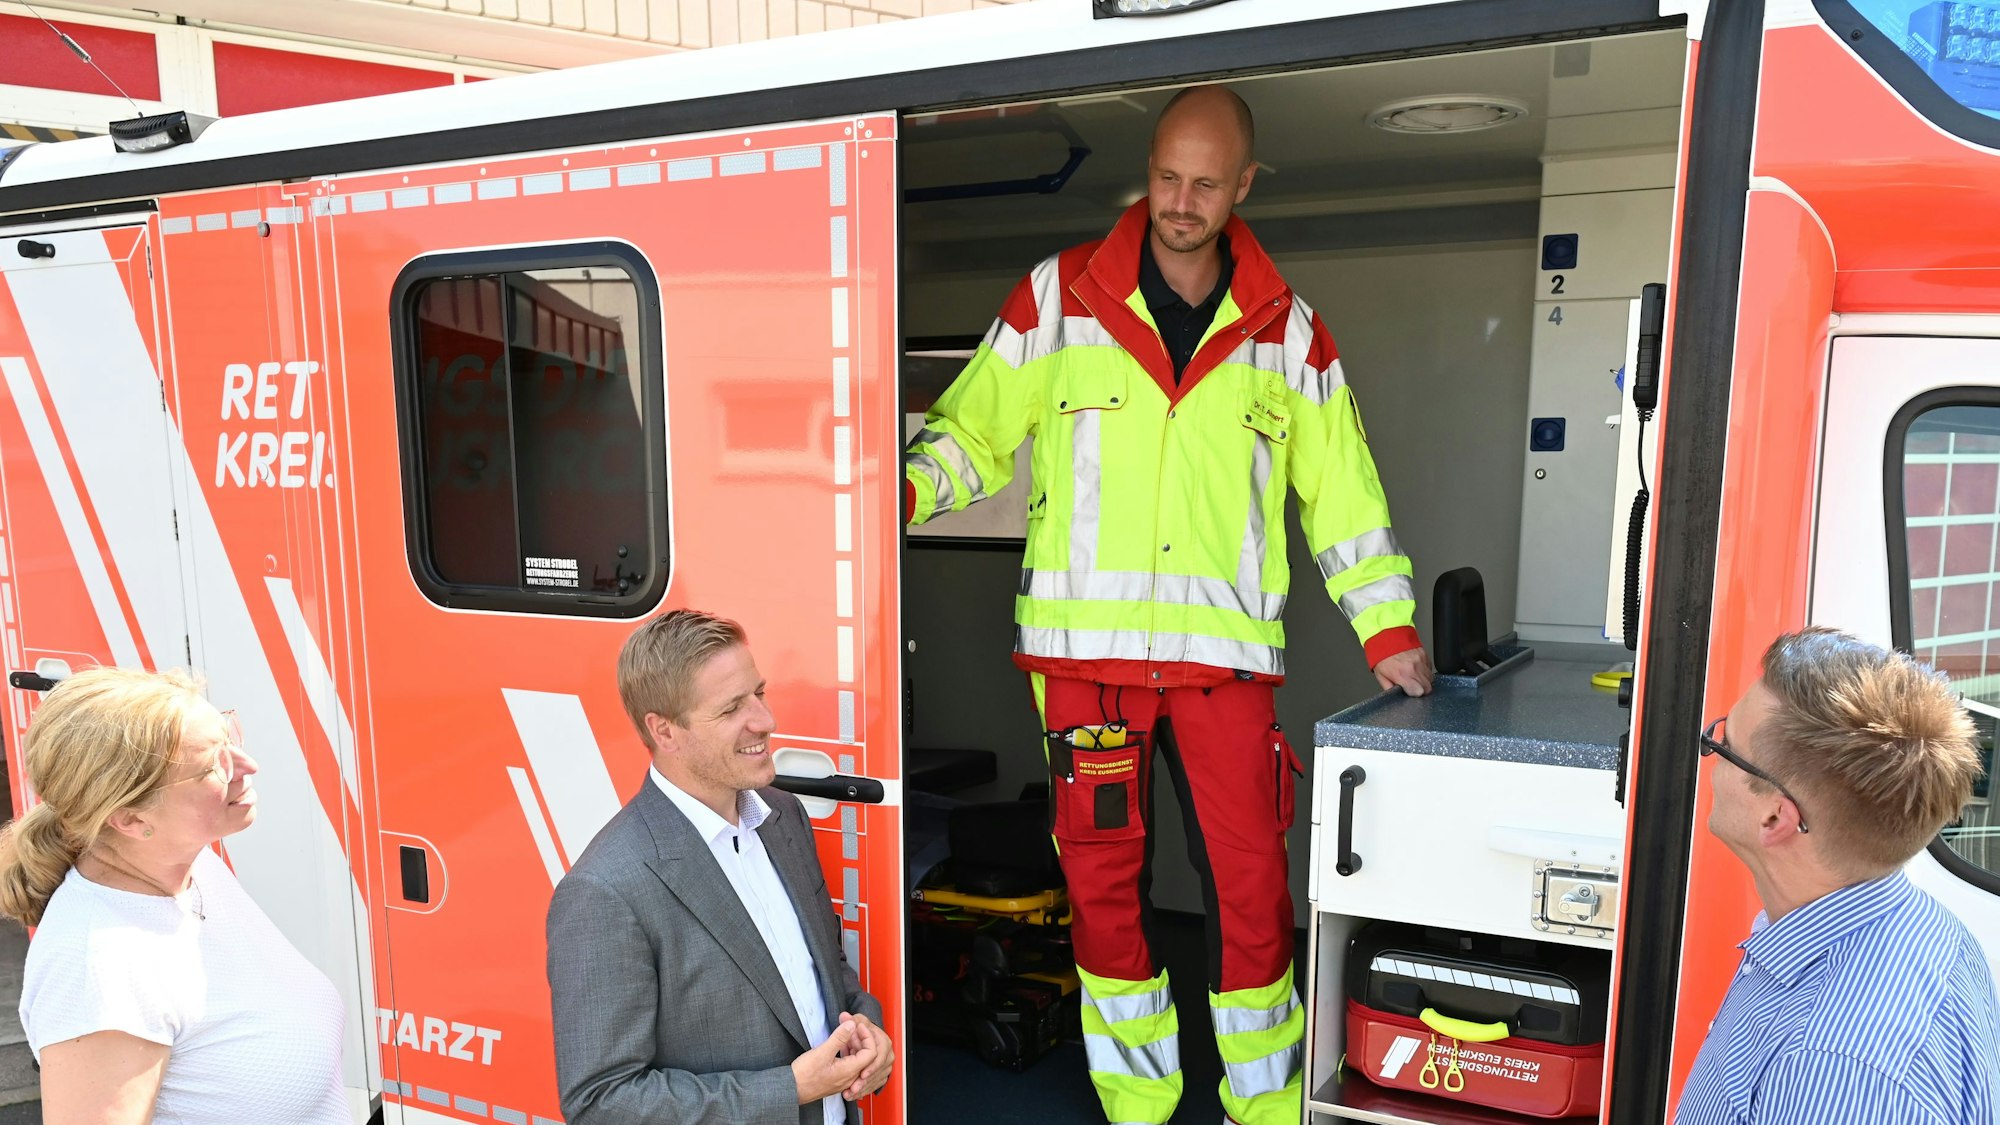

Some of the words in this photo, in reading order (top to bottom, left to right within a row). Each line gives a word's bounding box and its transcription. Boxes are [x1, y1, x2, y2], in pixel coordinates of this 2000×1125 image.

[1551, 275, 1564, 294] 2
[1548, 306, 1563, 326] 4
[221, 361, 324, 420] RET
[525, 557, 550, 568] SYSTEM
[551, 558, 578, 570] STROBEL
[1079, 759, 1133, 769] RETTUNGSDIENST
[1098, 766, 1134, 775] EUSKIRCHEN
[1504, 1057, 1540, 1072] KREIS
